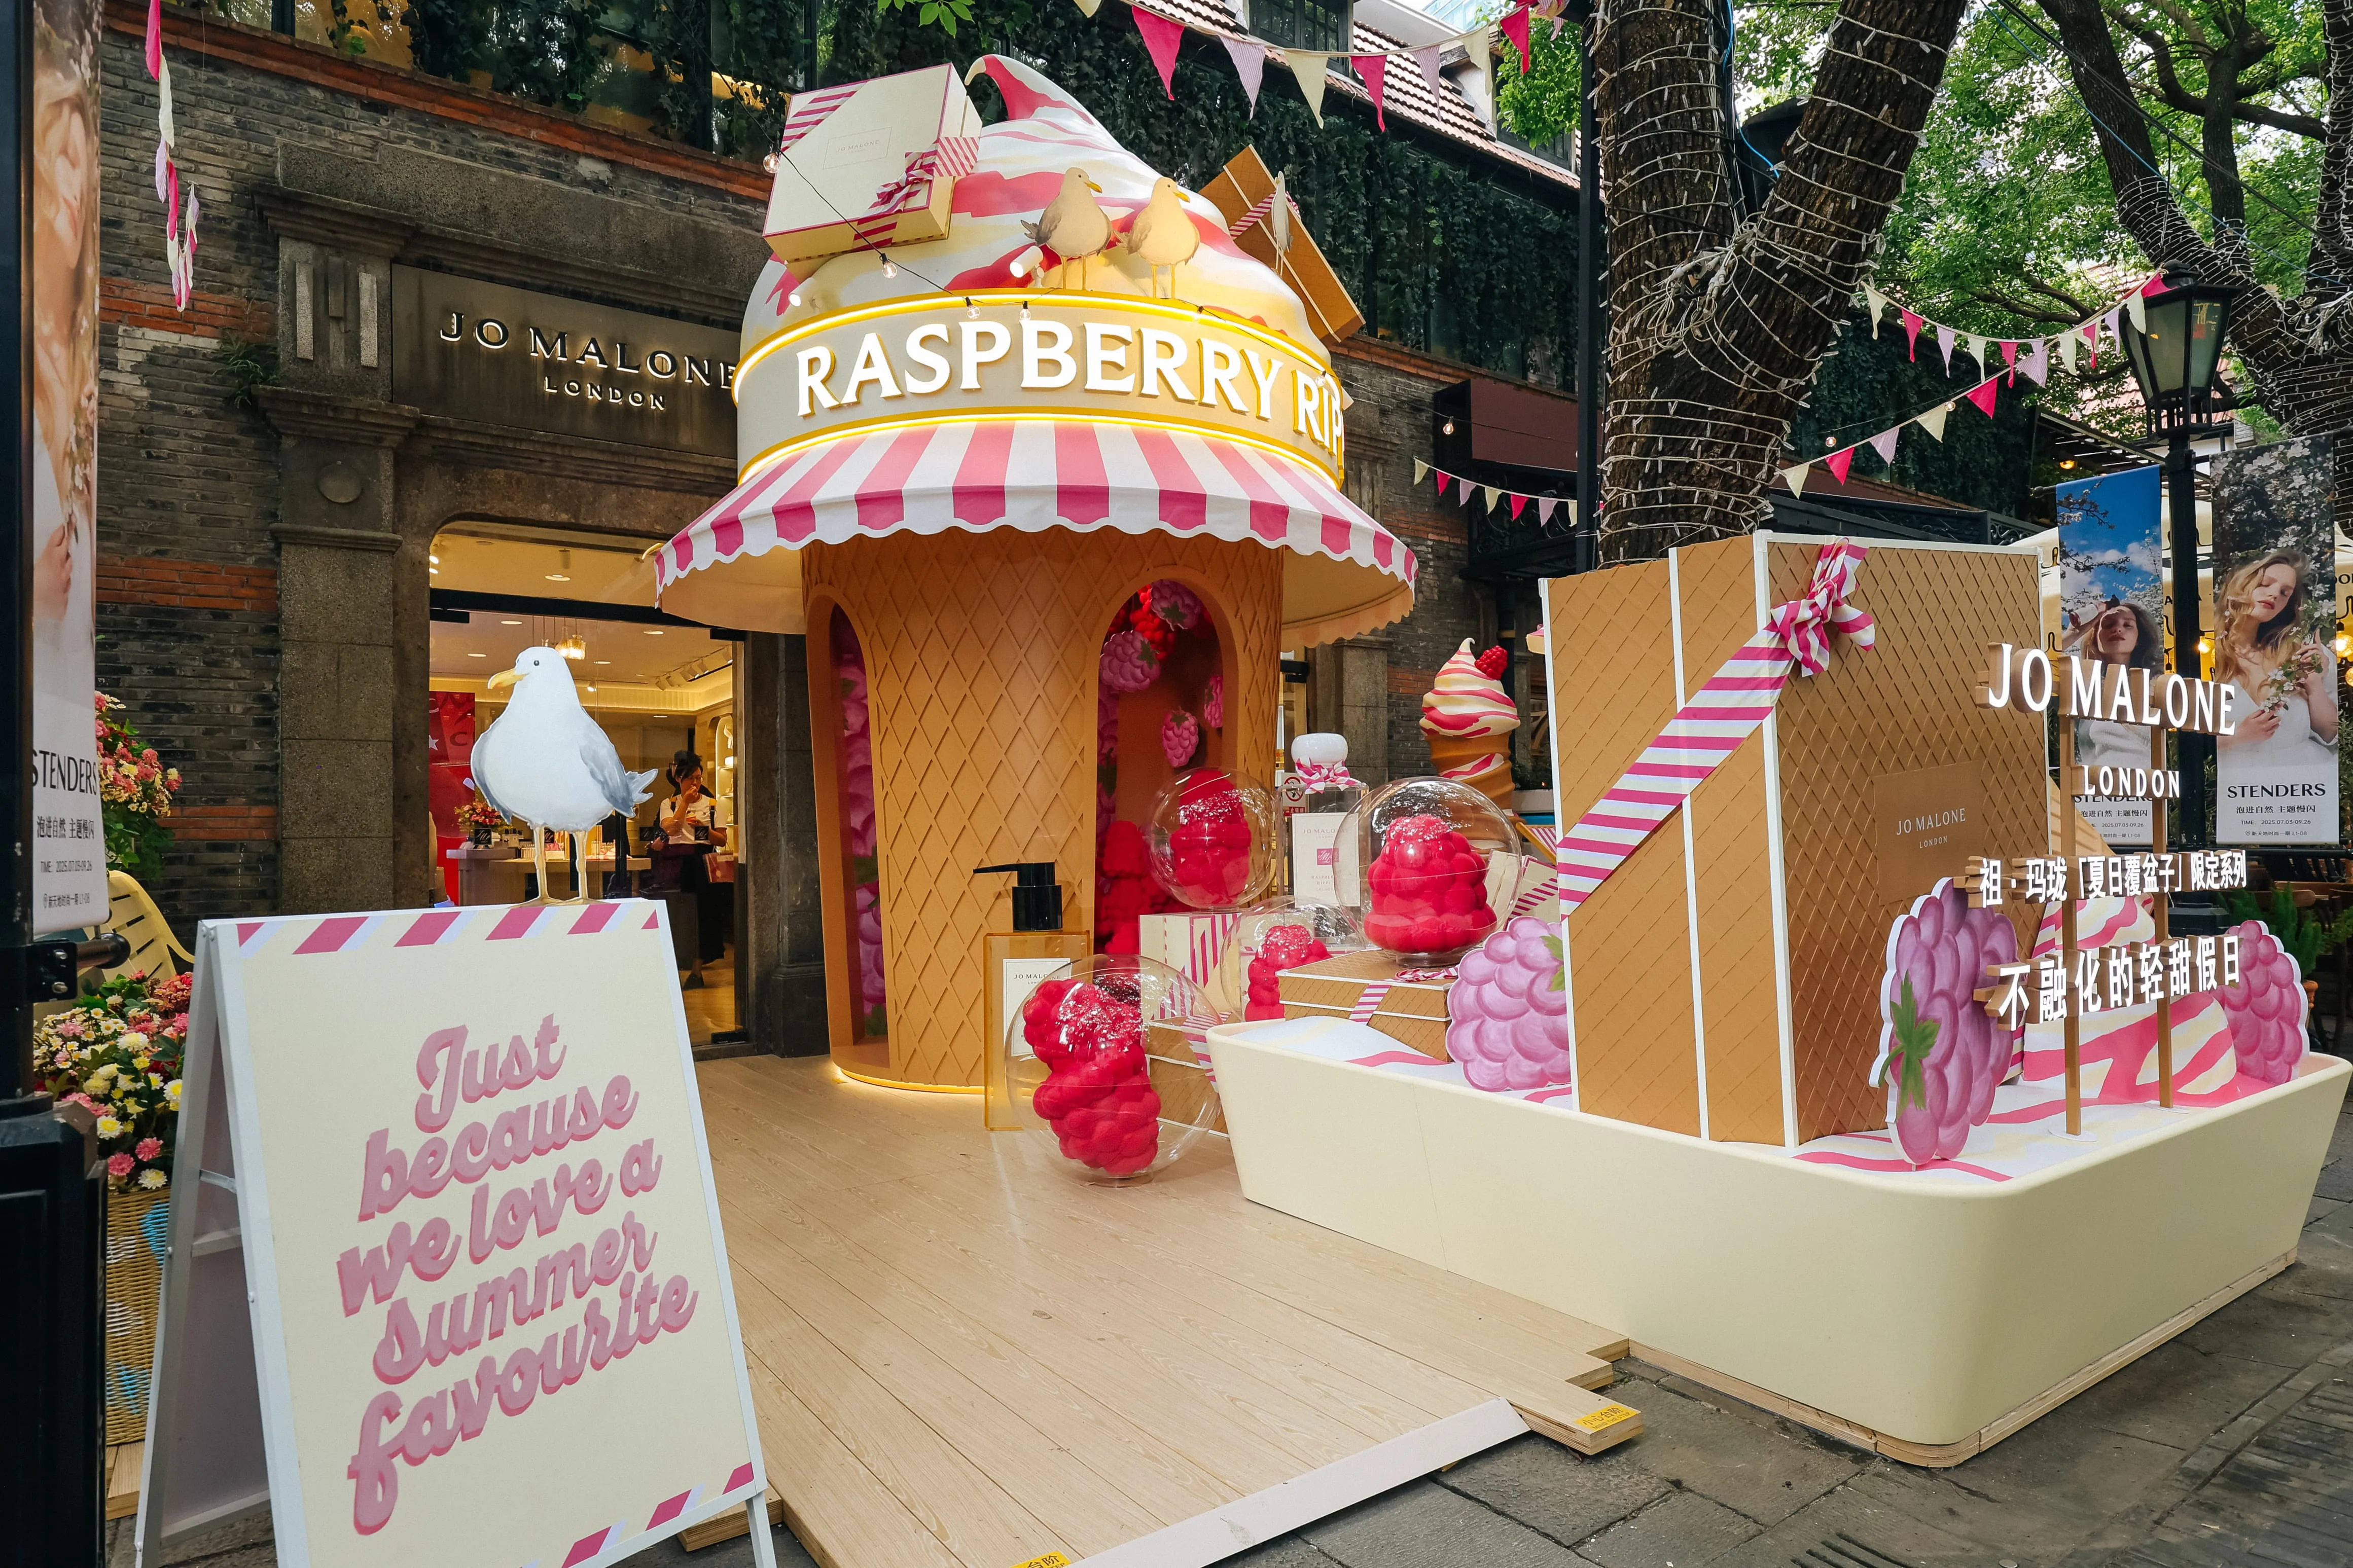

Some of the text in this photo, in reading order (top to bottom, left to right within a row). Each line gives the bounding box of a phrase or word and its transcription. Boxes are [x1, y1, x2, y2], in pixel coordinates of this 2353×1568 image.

[440, 311, 736, 390] JO MALONE
[543, 376, 666, 411] LONDON
[796, 320, 1345, 469] RASPBERRY RIP
[1988, 642, 2236, 736] JO MALONE
[2081, 764, 2180, 798] LONDON
[2227, 783, 2326, 798] STENDERS
[2236, 804, 2316, 814] 泡进自然 主题慢闪
[1896, 808, 1967, 835] JO MALONE
[2116, 809, 2148, 817] 主题慢闪
[1919, 835, 1948, 849] LONDON
[1998, 935, 2240, 1031] 不融化的轻甜假日
[414, 1012, 567, 1134] Just
[358, 1074, 639, 1223] because
[337, 1138, 663, 1317] we love a
[372, 1210, 658, 1385] summer
[347, 1271, 699, 1536] favourite
[1582, 1407, 1623, 1425] 小心台阶
[1027, 1555, 1060, 1568] 台阶
